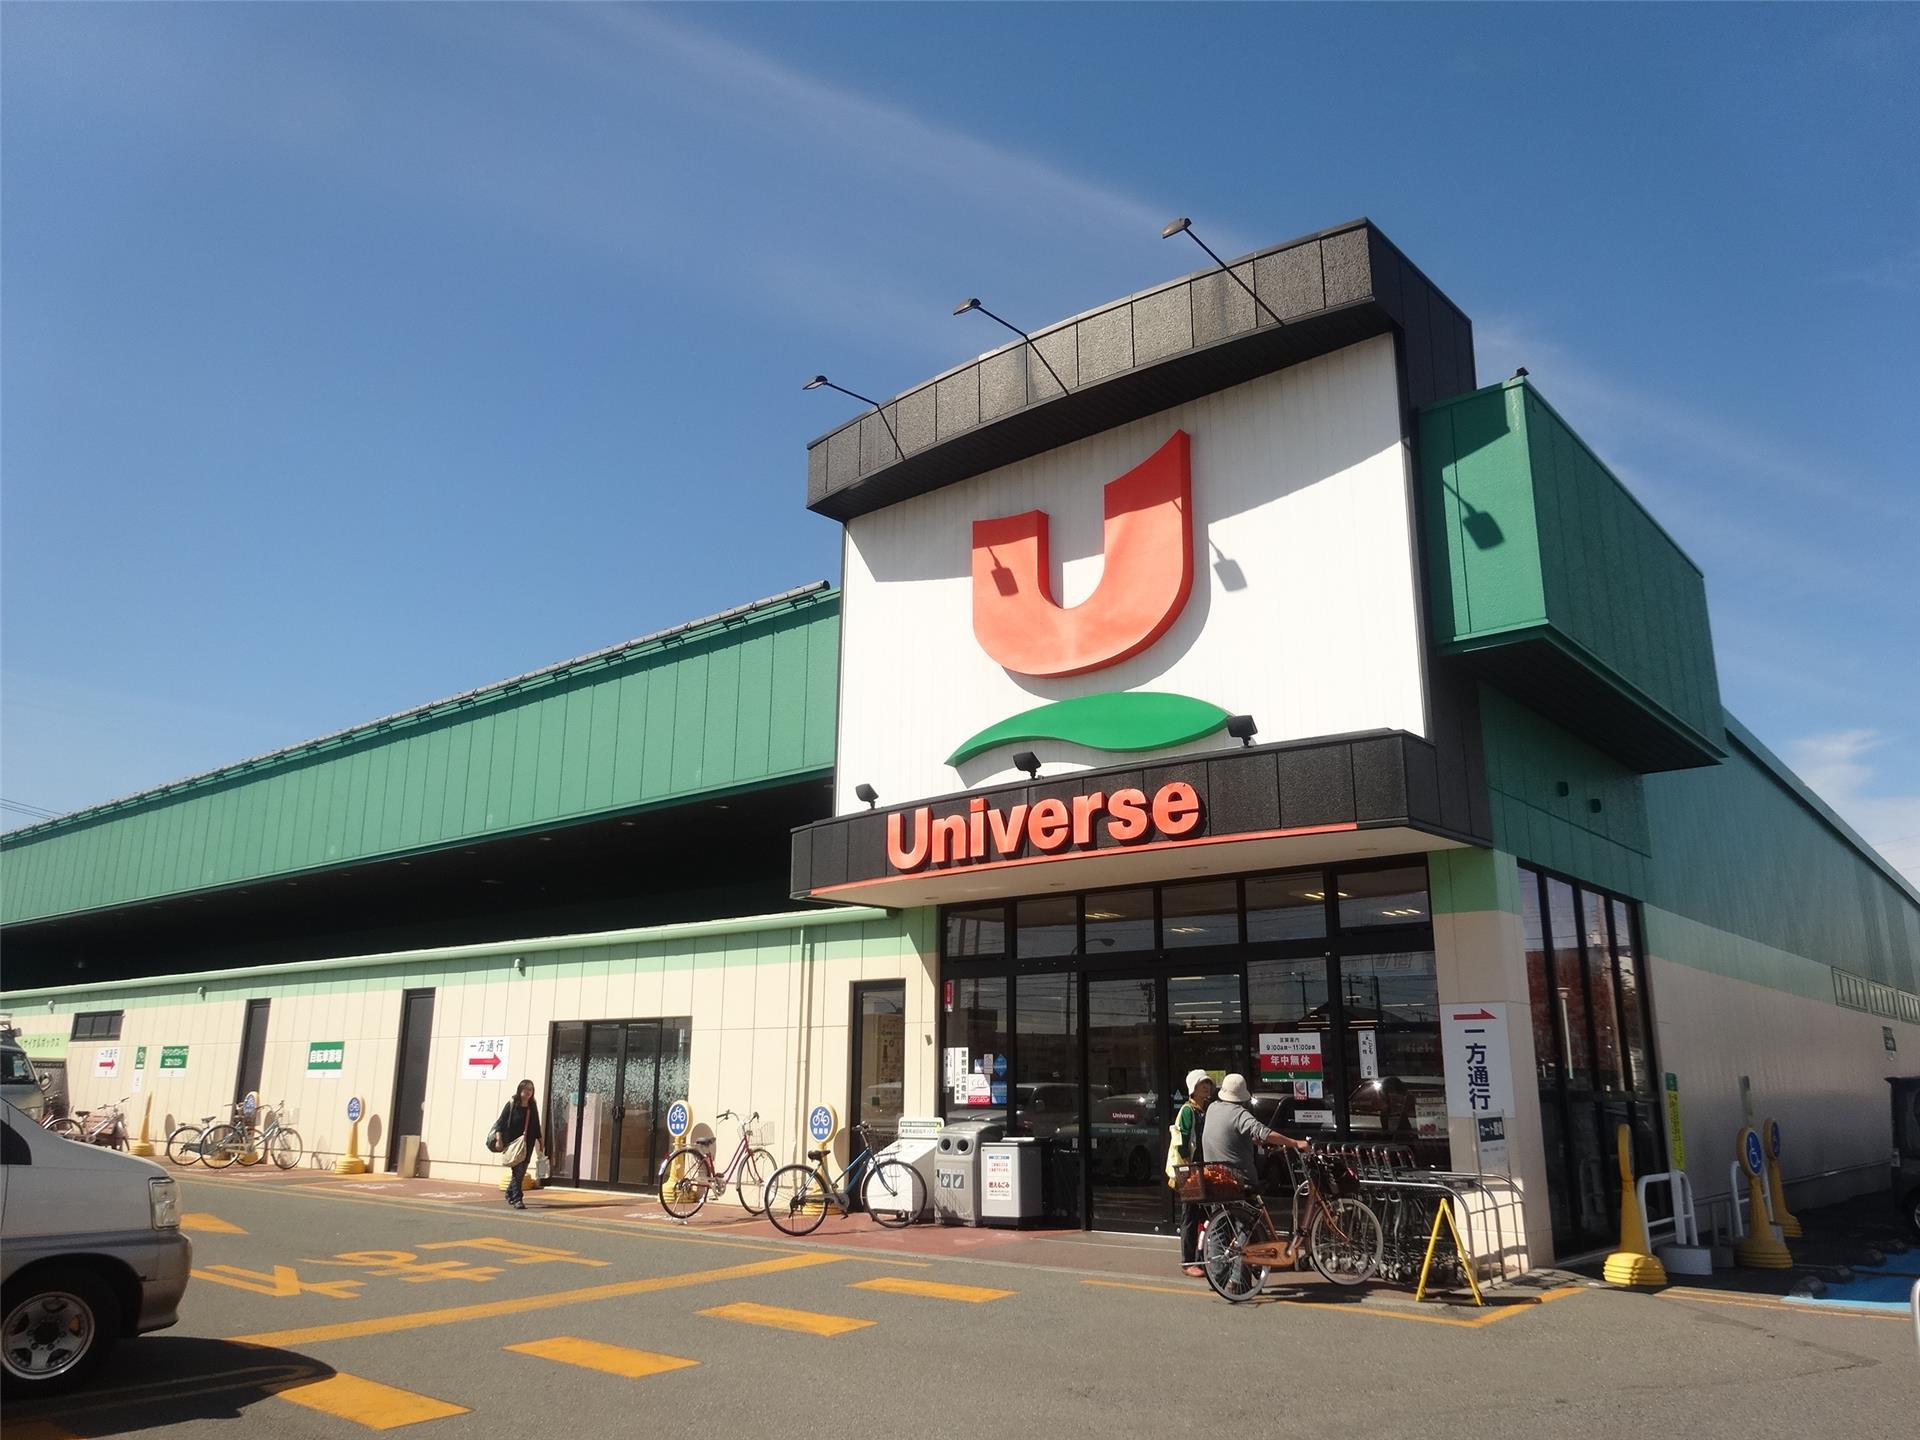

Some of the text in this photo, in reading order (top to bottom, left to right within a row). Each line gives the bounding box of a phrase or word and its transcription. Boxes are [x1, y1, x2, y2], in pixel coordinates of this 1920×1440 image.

[971, 429, 1193, 678] U
[886, 781, 1203, 871] Universe
[470, 1039, 504, 1052] 一方通行
[309, 1049, 342, 1063] 自転車置場
[1270, 1055, 1311, 1066] 年中無休
[1464, 1028, 1491, 1110] 一方通行
[988, 1181, 1010, 1189] 燃えるごみ
